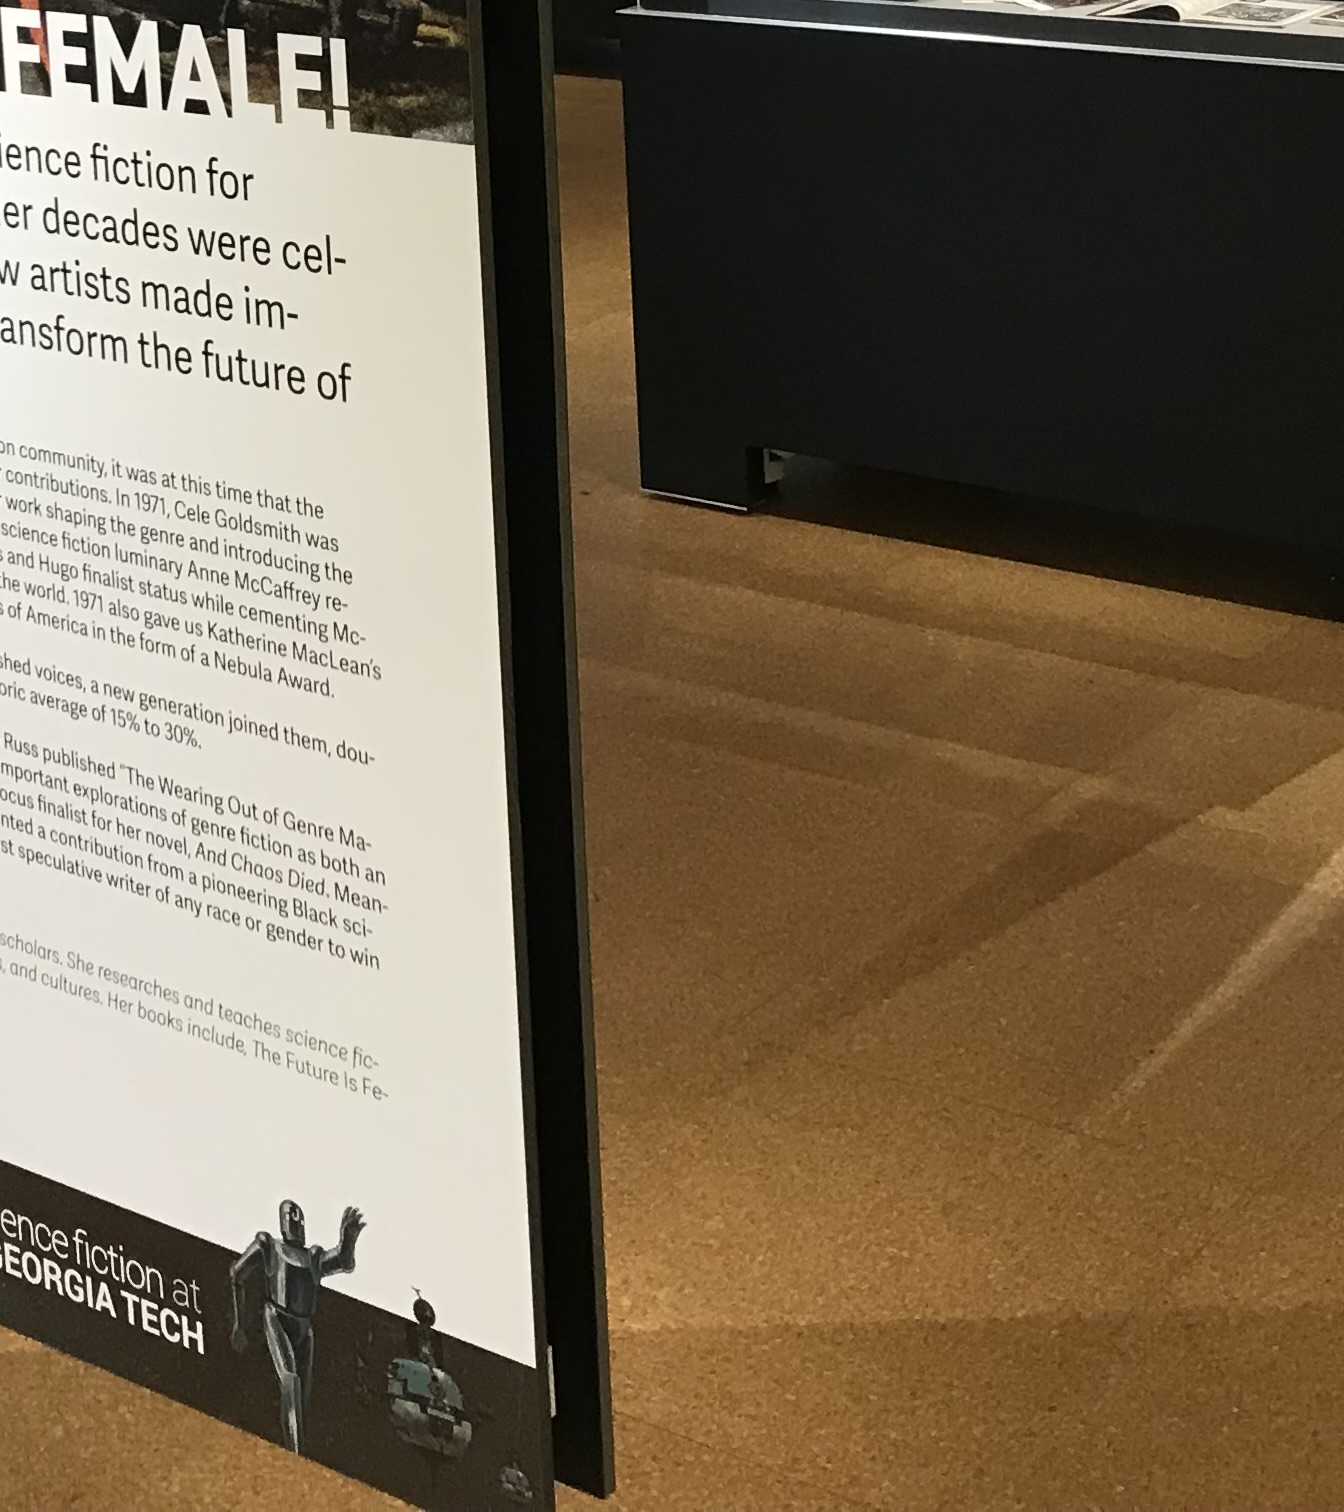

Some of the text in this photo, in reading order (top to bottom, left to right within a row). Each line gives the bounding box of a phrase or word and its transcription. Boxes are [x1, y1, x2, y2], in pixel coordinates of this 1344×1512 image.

[0, 5, 352, 132] FEMALE!
[89, 141, 197, 195] fiction
[205, 156, 255, 202] for
[42, 196, 179, 253] decades
[186, 226, 271, 266] were
[282, 233, 347, 276] cel-
[30, 258, 132, 305] artists
[141, 278, 234, 322] made
[243, 284, 299, 331] im-
[137, 330, 193, 375] the
[201, 338, 306, 396] future
[316, 361, 352, 404] of
[18, 444, 108, 479] community,
[111, 457, 123, 479] it
[124, 466, 158, 486] was
[161, 471, 178, 491] at
[180, 473, 212, 497] this
[215, 480, 253, 506] time
[256, 487, 293, 515] that
[295, 496, 325, 520] the
[29, 690, 88, 721] average
[91, 703, 107, 724] of
[110, 707, 141, 733] 15%
[143, 717, 161, 738] to
[164, 721, 202, 750] 30%.
[73, 1228, 165, 1300] fiction
[172, 1276, 202, 1316] at
[120, 1290, 205, 1355] TECH
